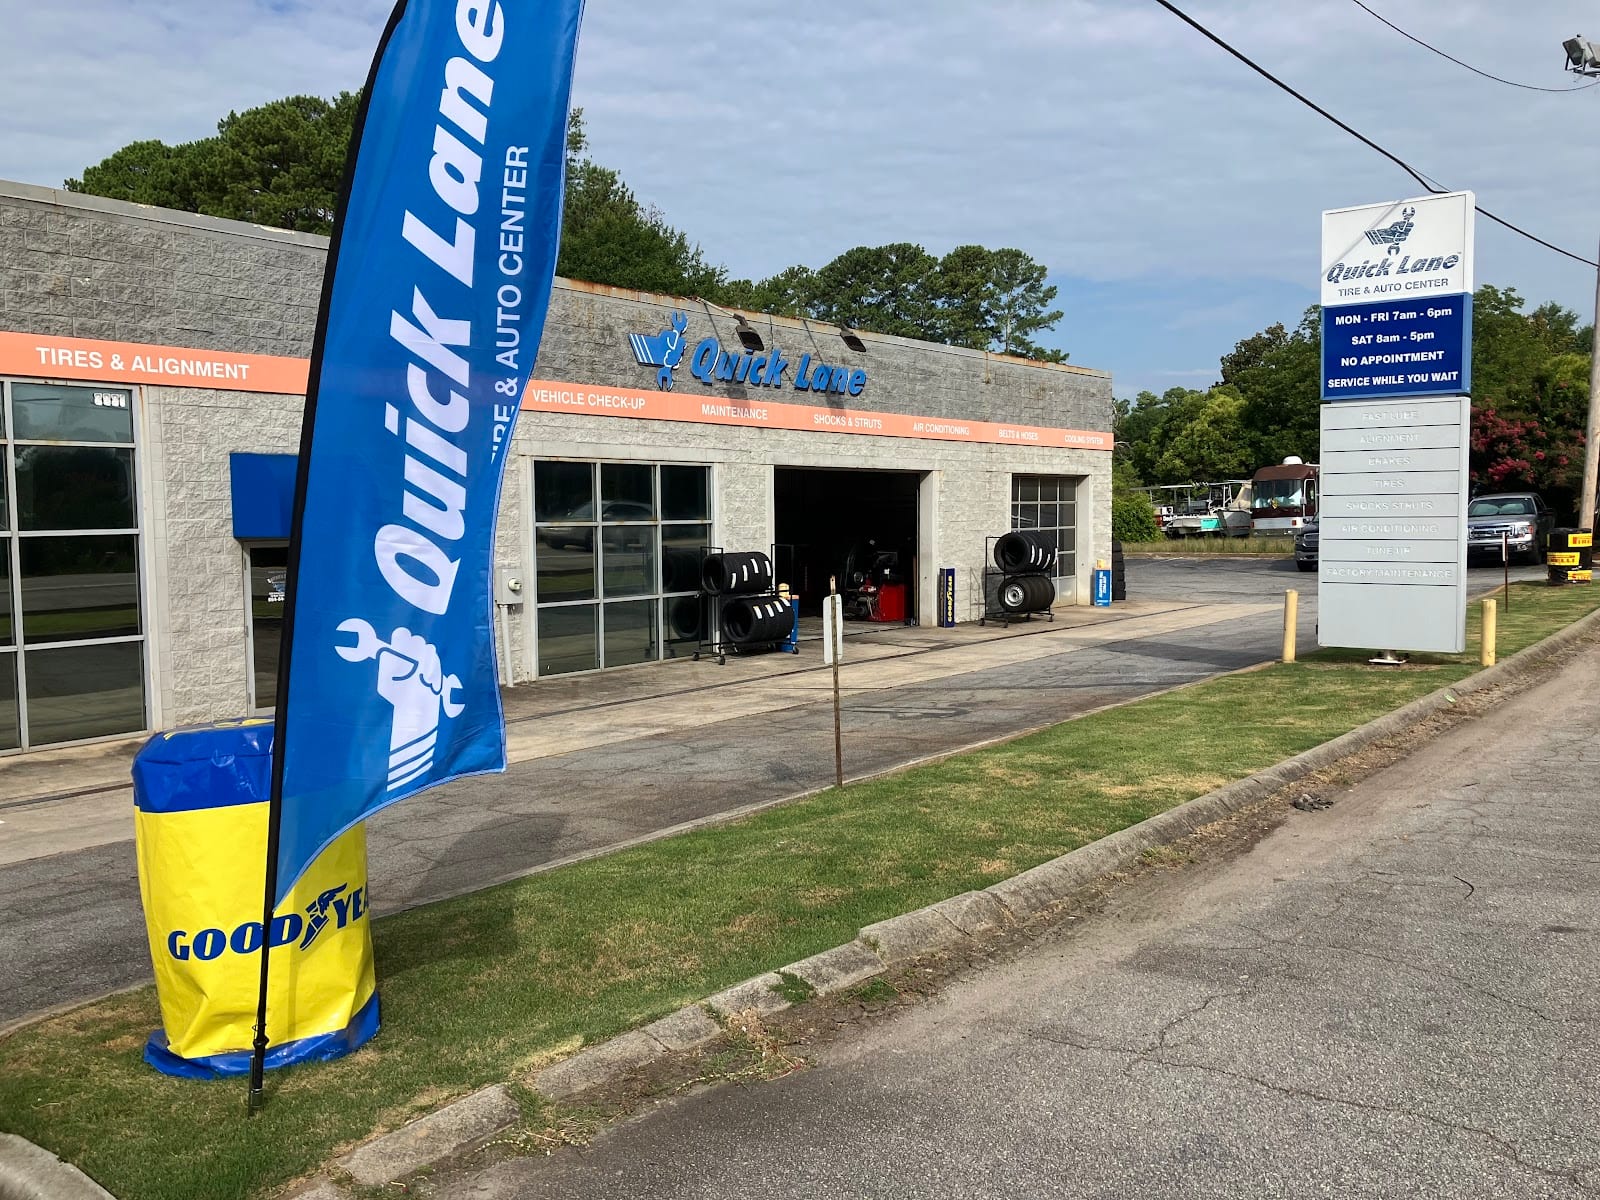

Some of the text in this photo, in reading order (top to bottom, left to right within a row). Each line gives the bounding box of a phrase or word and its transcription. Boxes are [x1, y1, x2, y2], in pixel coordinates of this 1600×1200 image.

[498, 145, 529, 276] CENTER
[1326, 254, 1459, 283] Quick Lane
[1338, 278, 1448, 297] TIRE & AUTO CENTER
[374, 0, 505, 615] Quick Lane
[1336, 314, 1361, 325] MON
[1371, 312, 1389, 322] FRI
[1392, 310, 1417, 320] 7am
[1427, 308, 1452, 319] 6pm
[495, 284, 522, 370] AUTO
[1352, 335, 1373, 345] SAT
[1376, 334, 1400, 344] 8am
[1410, 331, 1434, 342] 5pm
[36, 347, 250, 380] TIRES & ALIGNMENT
[1341, 351, 1444, 366] NO APPOINTMENT
[690, 338, 866, 397] Quick Lane
[494, 377, 518, 396] &
[1328, 371, 1458, 388] SERVICE WHILE YOU WAIT
[532, 389, 645, 410] VEHICLE CHECK-UP
[701, 404, 768, 420] MAINTENANCE
[1362, 411, 1387, 421] FAST
[813, 414, 882, 429] SHOCKS & STRUTS
[913, 422, 970, 436] AIR CONDITIONING
[998, 429, 1015, 439] BELTS
[1021, 432, 1038, 441] HOSES
[1360, 434, 1419, 444] ALIGNMENT
[1368, 456, 1411, 466] BRAKES
[1374, 479, 1404, 488] TIRES
[1347, 501, 1433, 510] SHOCKS STRUTS
[1342, 524, 1438, 533] AIR CONDITIONING
[1327, 568, 1452, 578] FACTORY MAINTENANCE
